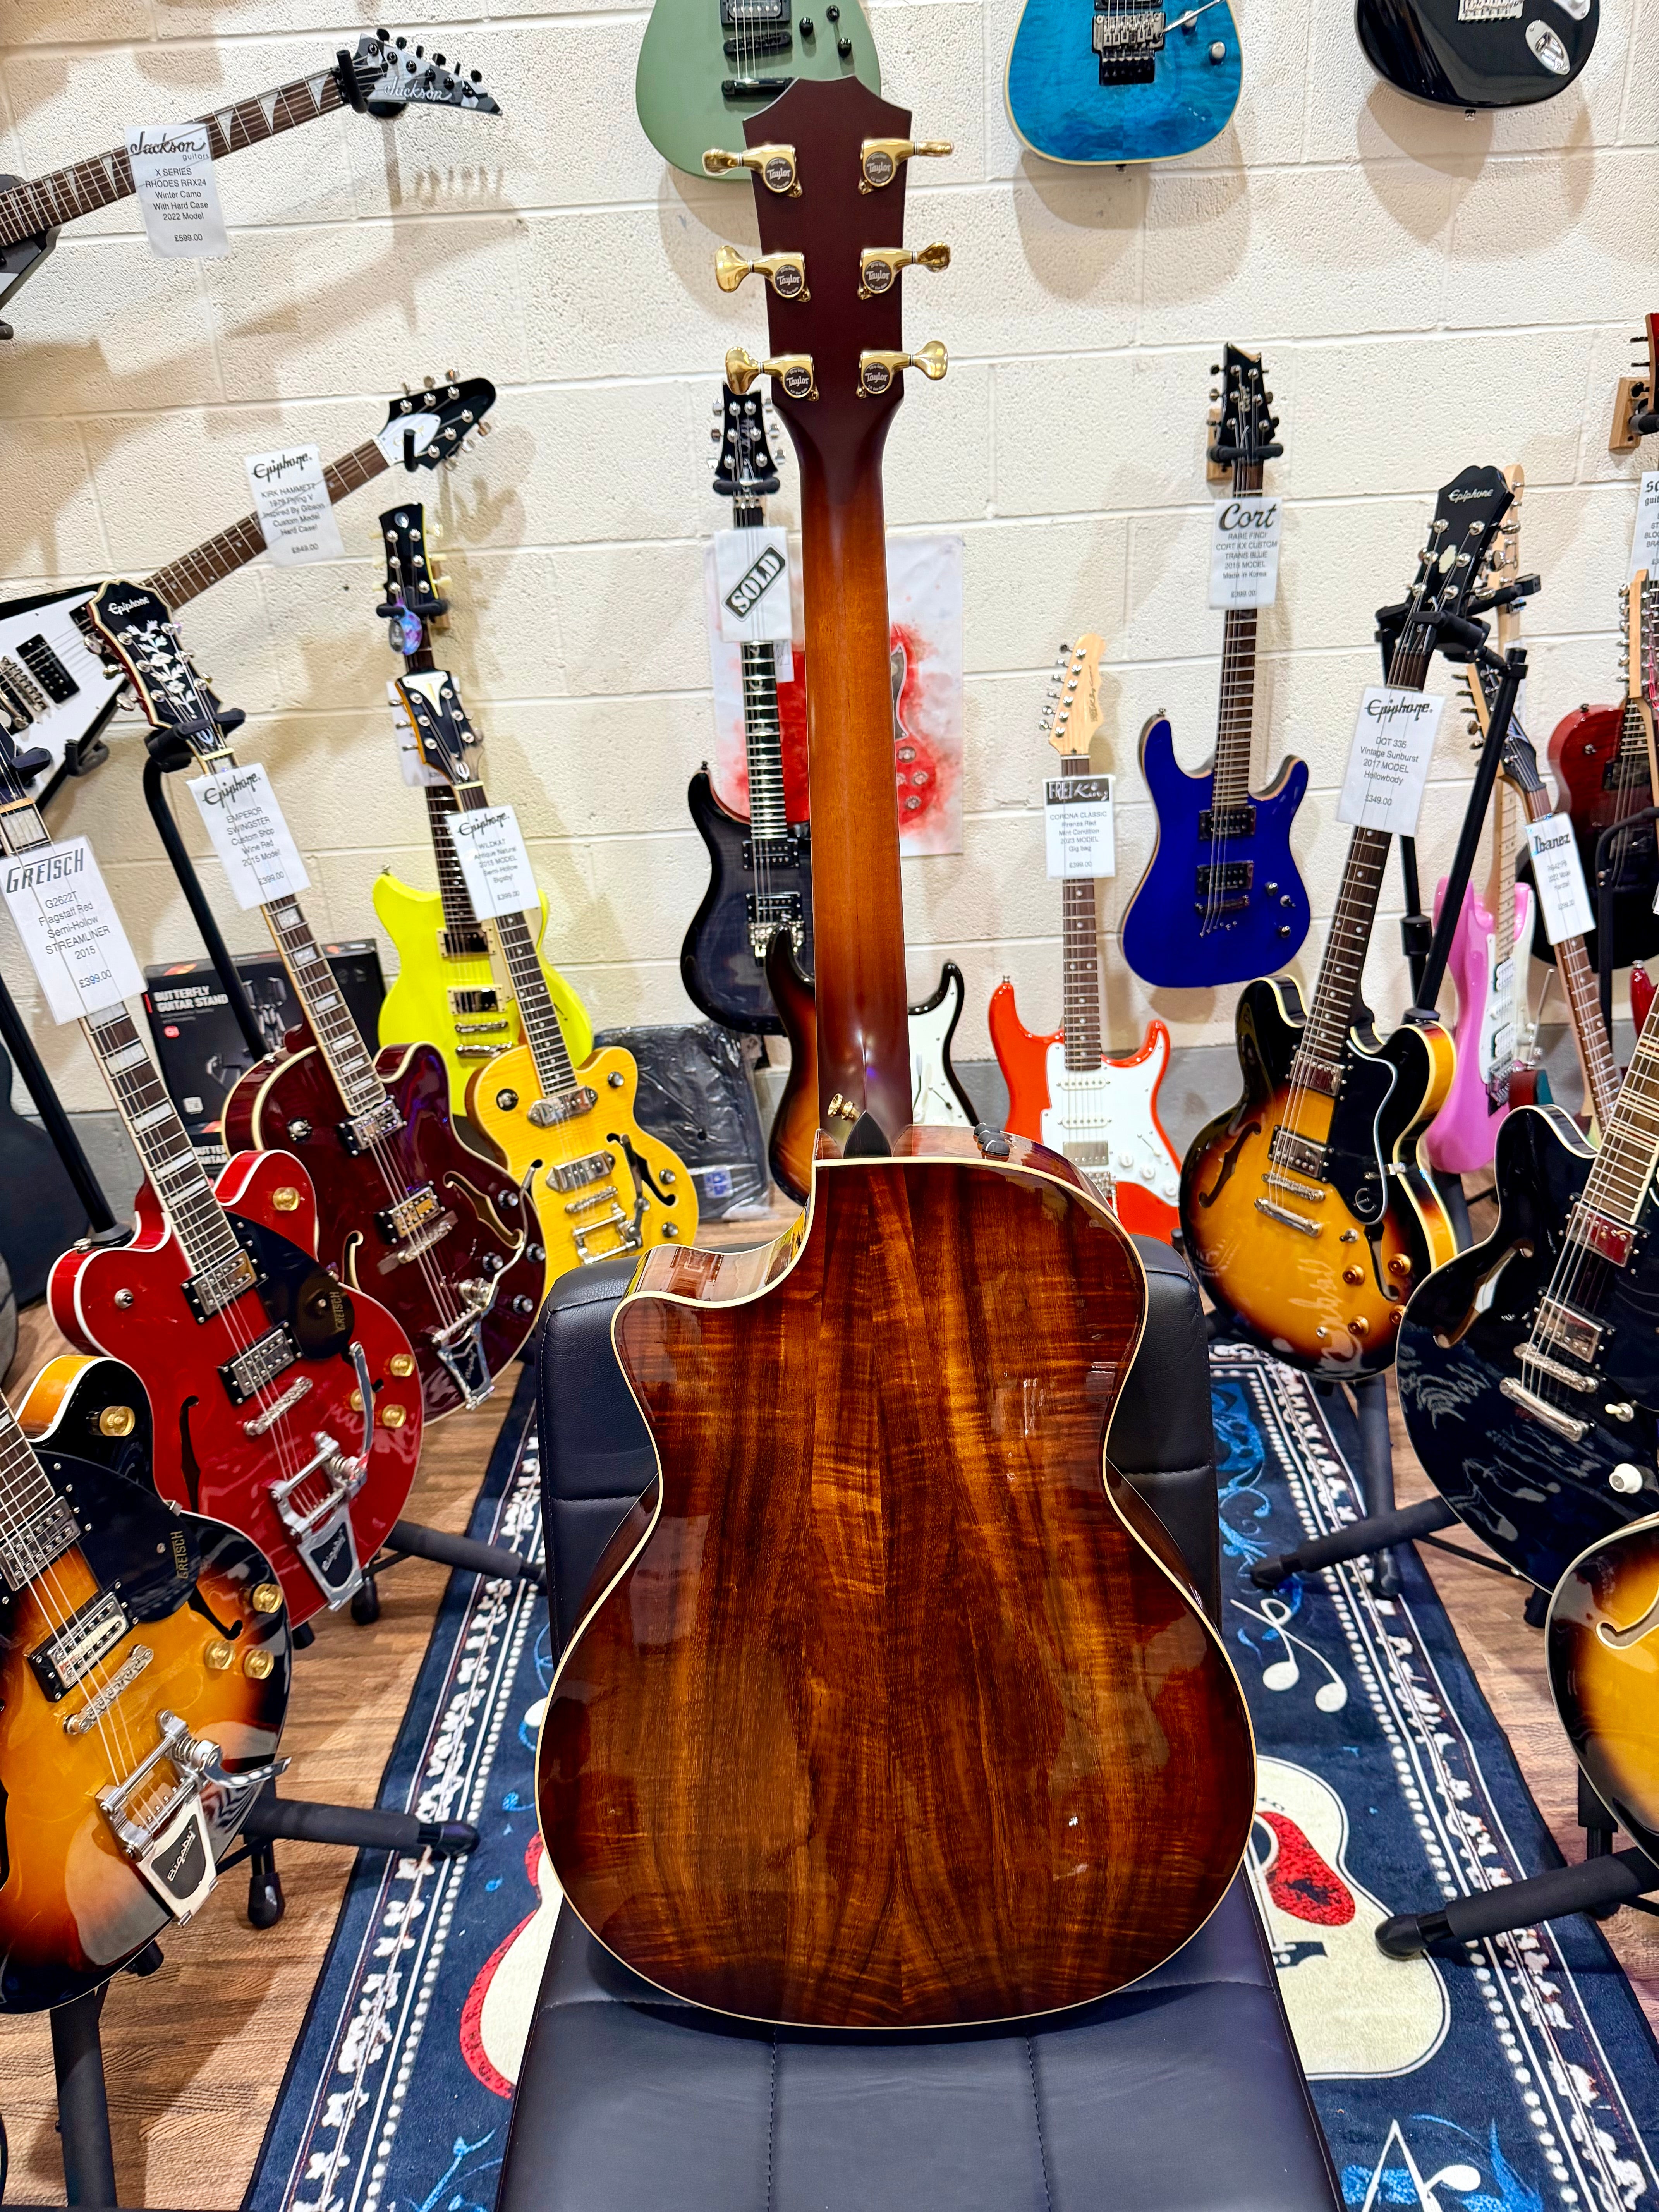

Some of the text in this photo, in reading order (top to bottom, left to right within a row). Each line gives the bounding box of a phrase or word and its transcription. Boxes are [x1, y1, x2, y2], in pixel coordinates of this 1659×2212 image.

[384, 76, 452, 101] Jackson
[130, 131, 206, 155] Jackson
[182, 153, 209, 161] guitars
[163, 168, 192, 176] SERIES
[767, 167, 791, 180] Taylor
[867, 162, 891, 174] Taylor
[145, 180, 179, 188] RHODES
[171, 201, 188, 210] Hard
[174, 234, 203, 242] £599.00
[776, 275, 801, 286] Taylor
[866, 270, 890, 282] Taylor
[786, 376, 809, 387] Taylor
[865, 372, 888, 383] Taylor
[1448, 488, 1494, 503] Epiphone
[1218, 503, 1277, 531] Cort
[1248, 541, 1278, 549] CUSTOM
[731, 555, 780, 614] SOLD
[107, 596, 150, 615] Epiphone
[1376, 737, 1407, 749] DOT 335
[1360, 746, 1419, 763] Vintage Sunburst
[1363, 759, 1409, 774] 2017 MODEL
[1364, 770, 1403, 786] Hollowbody
[1049, 781, 1109, 802] FRET King
[1365, 793, 1392, 806] £349.00
[227, 807, 263, 823] EMPEROR
[1050, 812, 1078, 821] CORONA
[227, 816, 271, 835] SWINGSTER
[232, 828, 275, 845] Custom Shop
[1533, 833, 1571, 855] Ibanez
[242, 840, 273, 854] Wine Red
[242, 856, 260, 867] 2015
[6, 848, 84, 894] GRETSCH
[45, 891, 78, 909] G2622T
[38, 901, 94, 926] Flagstaff Red
[47, 915, 99, 938] Semi-Hollow
[45, 925, 111, 955] STREAMLINER
[74, 945, 96, 960] 2015
[79, 969, 112, 988] £399.00
[154, 985, 210, 1002] BUTTERFLY
[156, 994, 229, 1012] GUITAR STAND
[329, 1291, 346, 1331] GRETSCH
[170, 1530, 189, 1579] GRETSCH
[167, 1829, 196, 1882] Bigsby
